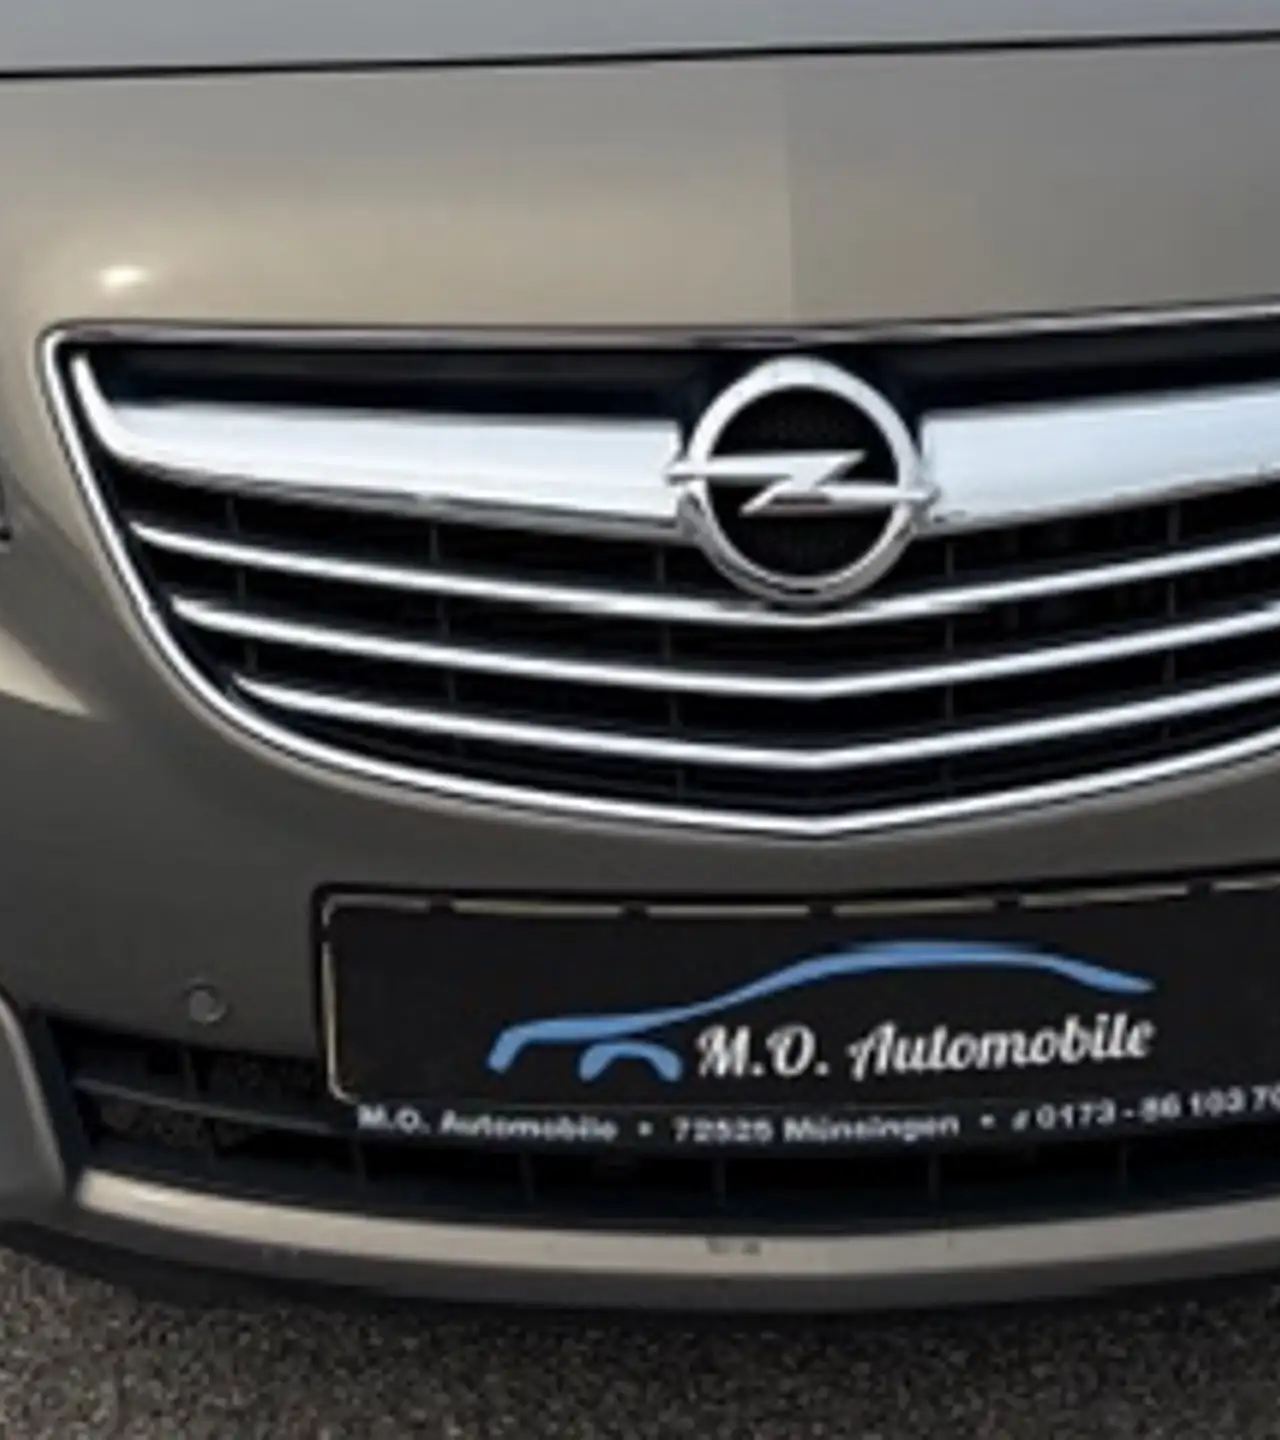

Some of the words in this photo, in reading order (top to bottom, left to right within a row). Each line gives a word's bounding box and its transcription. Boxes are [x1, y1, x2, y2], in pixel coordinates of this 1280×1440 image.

[695, 1023, 830, 1077] M.O.
[846, 1012, 1156, 1082] Automobile
[356, 1103, 431, 1135] M.O.
[439, 1108, 619, 1143] Automobile
[672, 1115, 774, 1144] 72525
[782, 1113, 961, 1144] Münsingen
